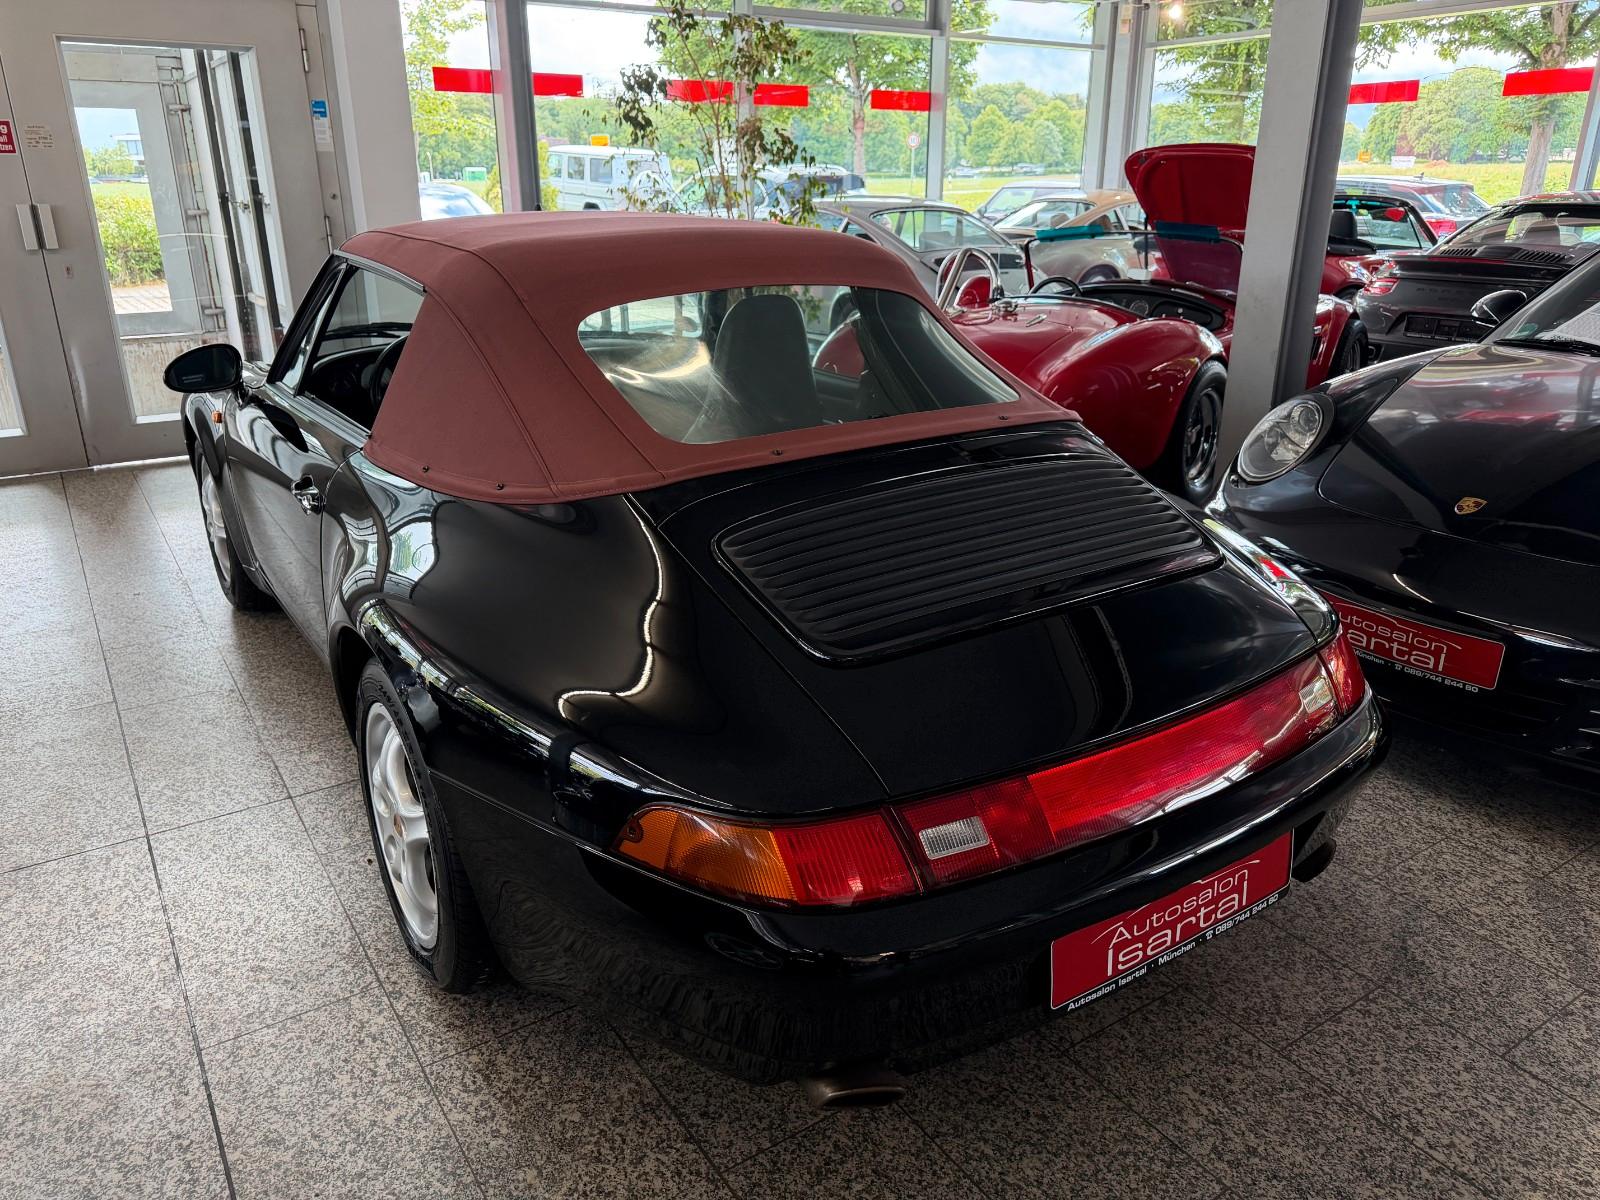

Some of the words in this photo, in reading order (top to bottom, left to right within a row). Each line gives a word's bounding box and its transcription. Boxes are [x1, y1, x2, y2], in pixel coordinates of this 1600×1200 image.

[1339, 611, 1447, 653] utosalon
[1347, 629, 1446, 672] artal
[1404, 667, 1442, 683] 089/744
[1107, 880, 1248, 977] Isartal
[1109, 869, 1248, 948] Autosalon
[1067, 984, 1116, 1011] Autosalon
[1118, 966, 1147, 987] Isartal
[1158, 941, 1196, 966] München
[1215, 912, 1250, 935] 089/744
[1252, 902, 1267, 915] 244
